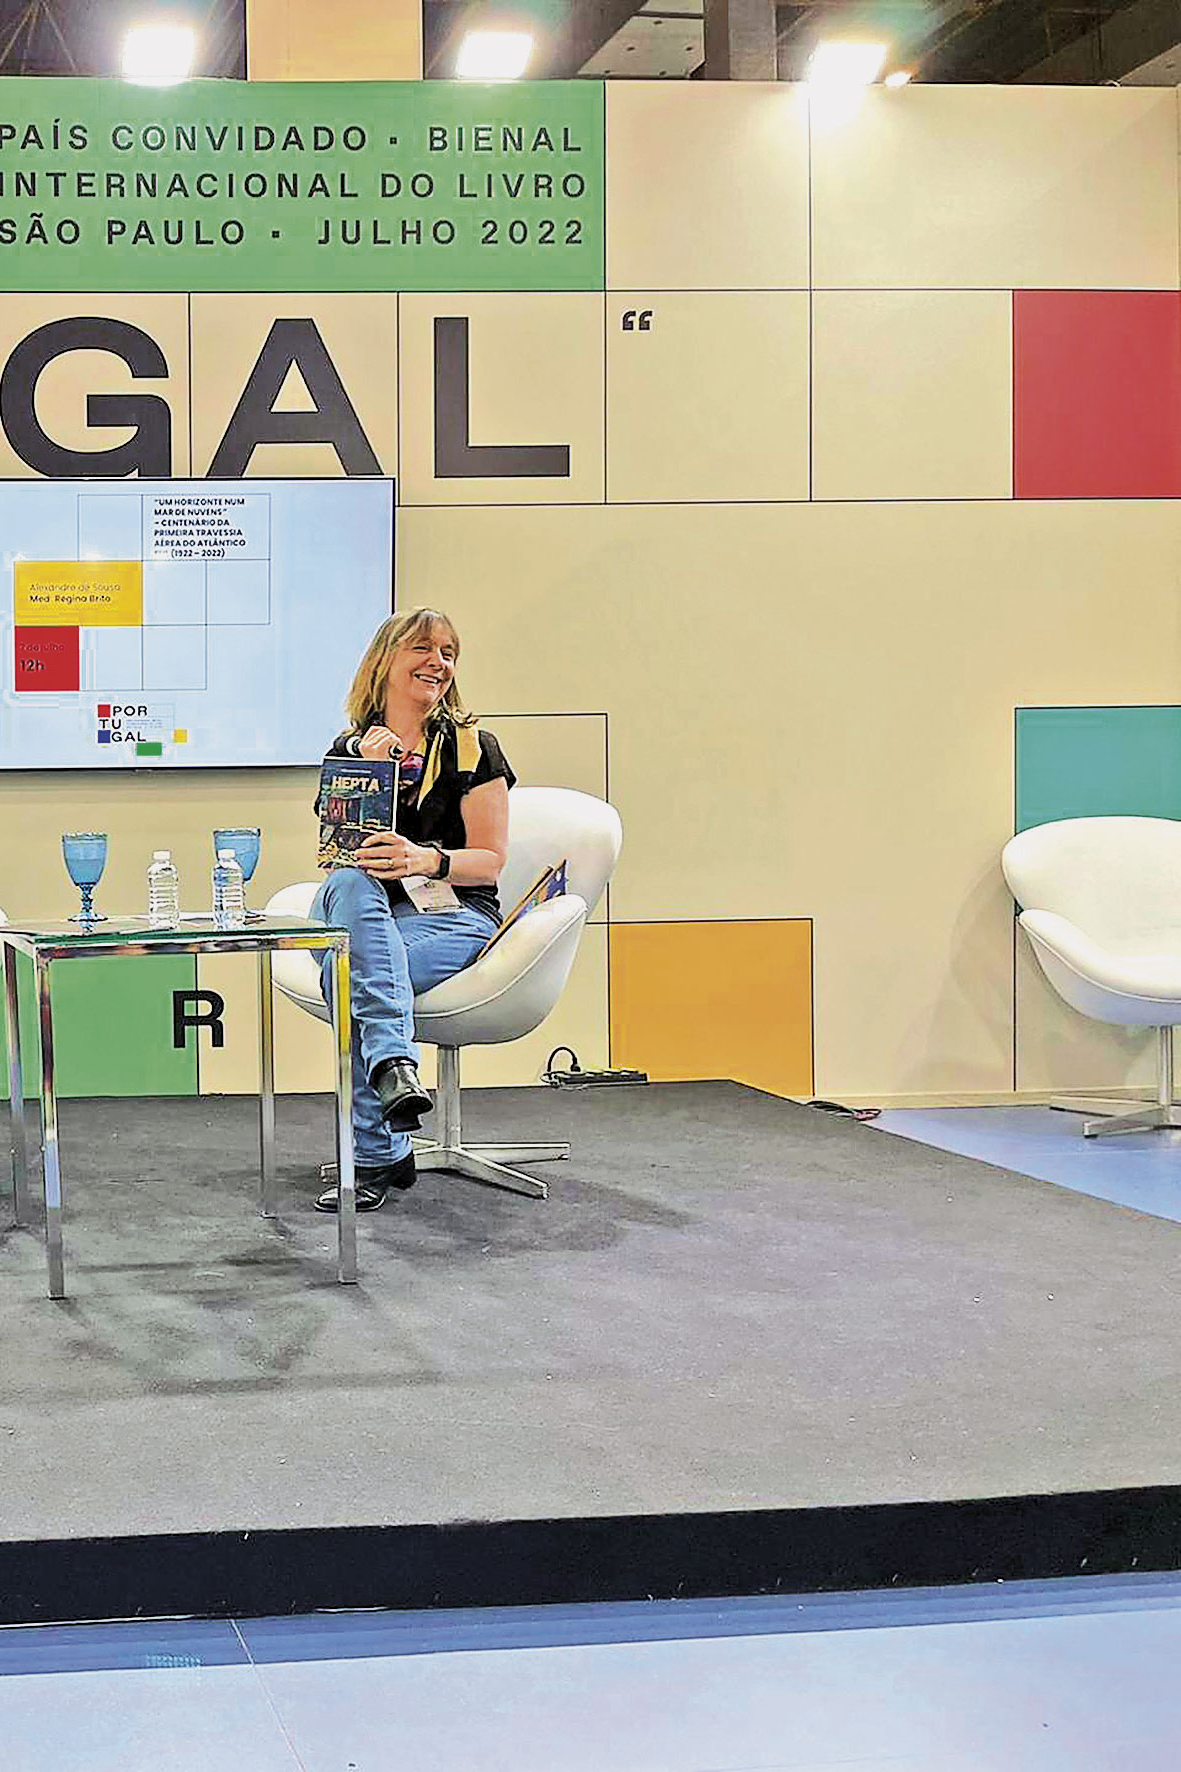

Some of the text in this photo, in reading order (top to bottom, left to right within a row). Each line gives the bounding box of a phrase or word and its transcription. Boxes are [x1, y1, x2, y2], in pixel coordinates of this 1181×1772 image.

[111, 125, 367, 151] CONVIDADO
[429, 127, 582, 151] BIENAL
[381, 173, 435, 198] DO
[459, 173, 586, 198] LIVRO
[107, 219, 245, 245] PAULO
[317, 219, 456, 245] JULHO
[481, 220, 583, 245] 2022
[174, 498, 223, 506] HORIZONTE
[224, 498, 245, 506] NUM
[154, 508, 174, 516] MAR
[174, 508, 186, 516] DE
[182, 539, 196, 547] DO
[54, 594, 87, 604] Regina
[89, 595, 111, 603] Brito
[21, 659, 44, 671] 12h
[113, 705, 148, 717] POR
[99, 719, 122, 730] TU
[111, 731, 147, 742] GAL
[332, 775, 380, 792] HEPTA
[172, 990, 225, 1049] R
